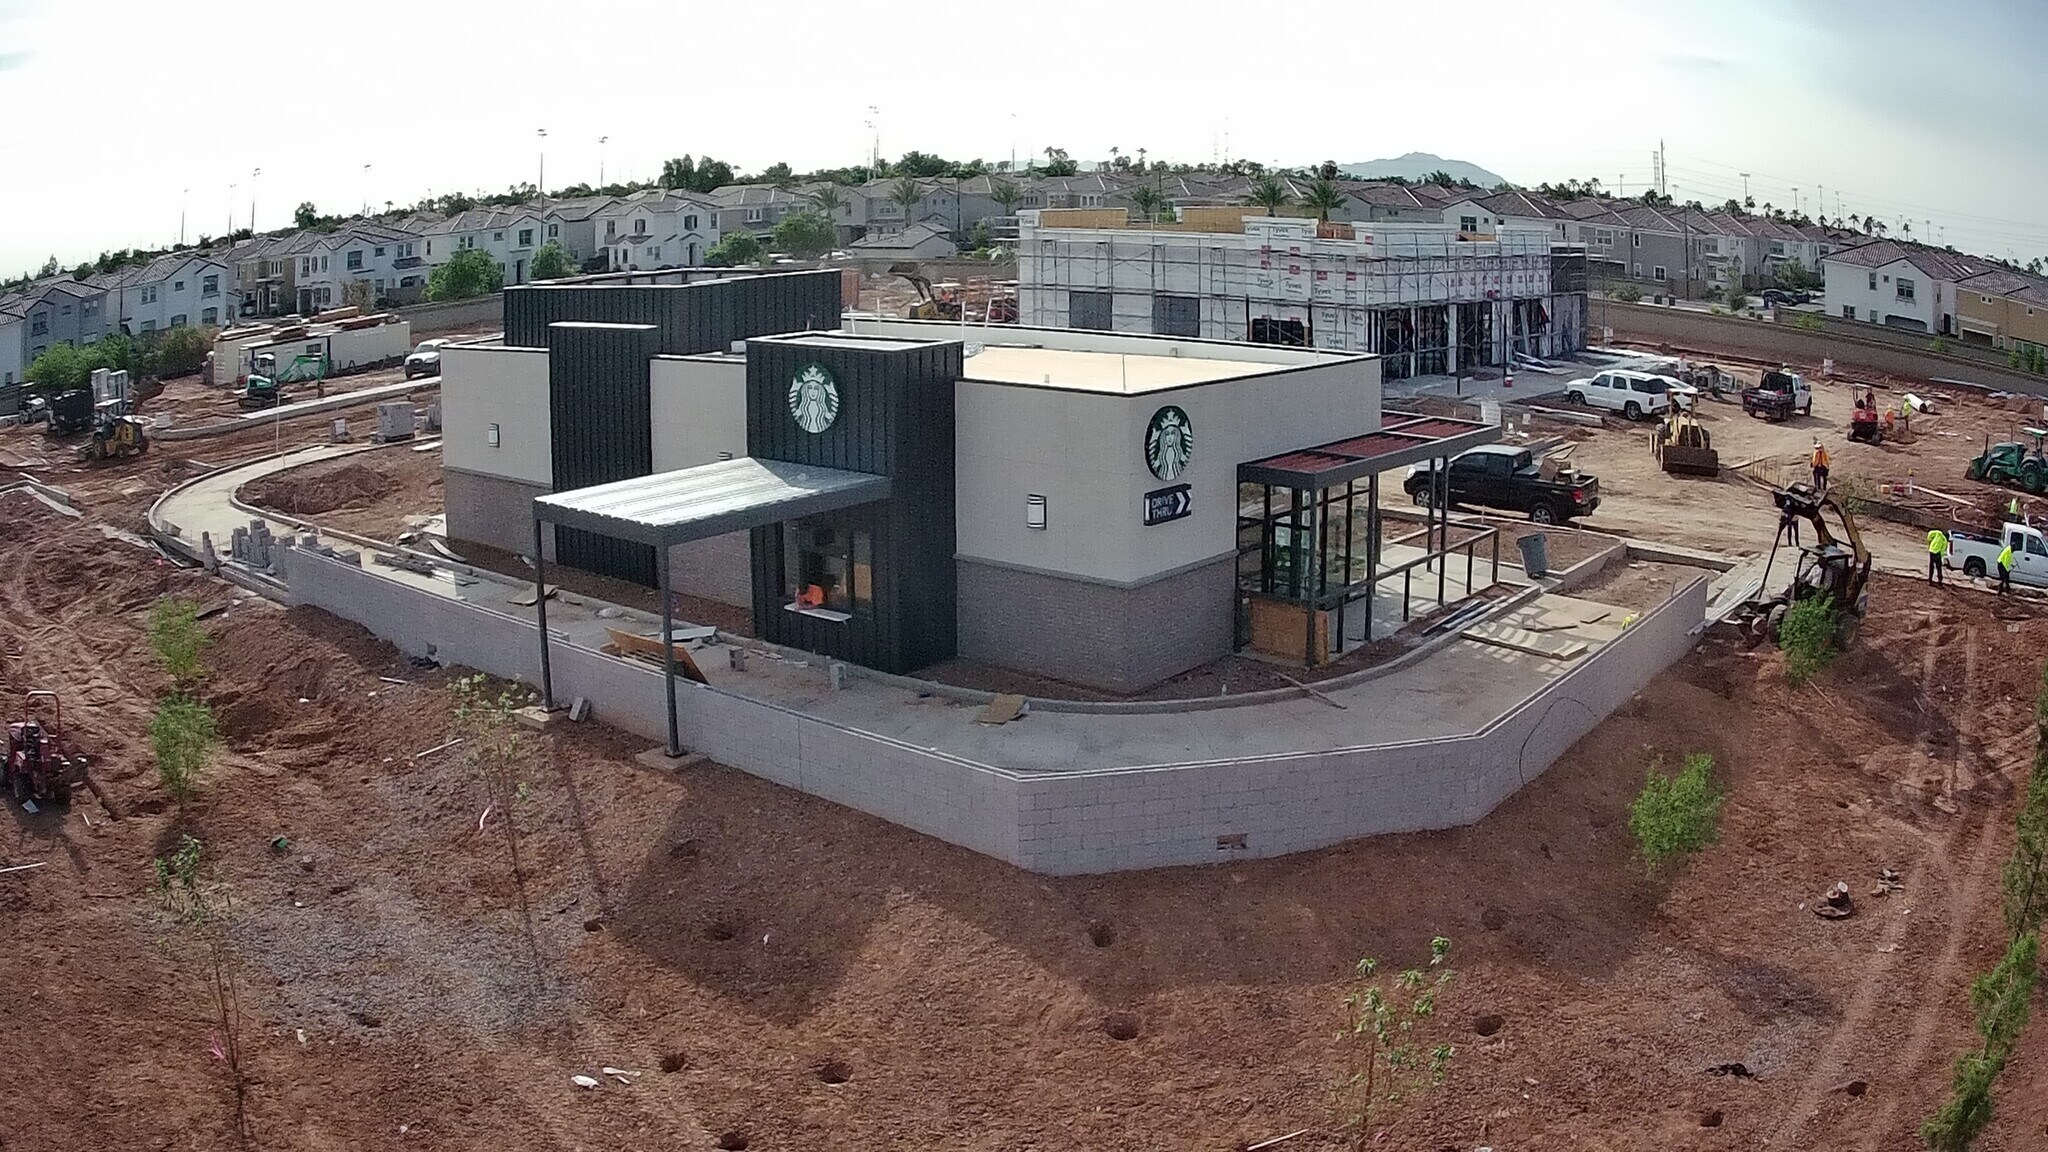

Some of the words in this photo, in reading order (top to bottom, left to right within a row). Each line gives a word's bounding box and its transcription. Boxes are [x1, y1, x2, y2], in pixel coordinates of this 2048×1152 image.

[1285, 281, 1302, 289] Tyvek
[1314, 287, 1332, 295] Tyvek
[1326, 337, 1344, 345] Tyvek
[1151, 494, 1174, 509] DRIVE
[1152, 506, 1174, 520] THRU
